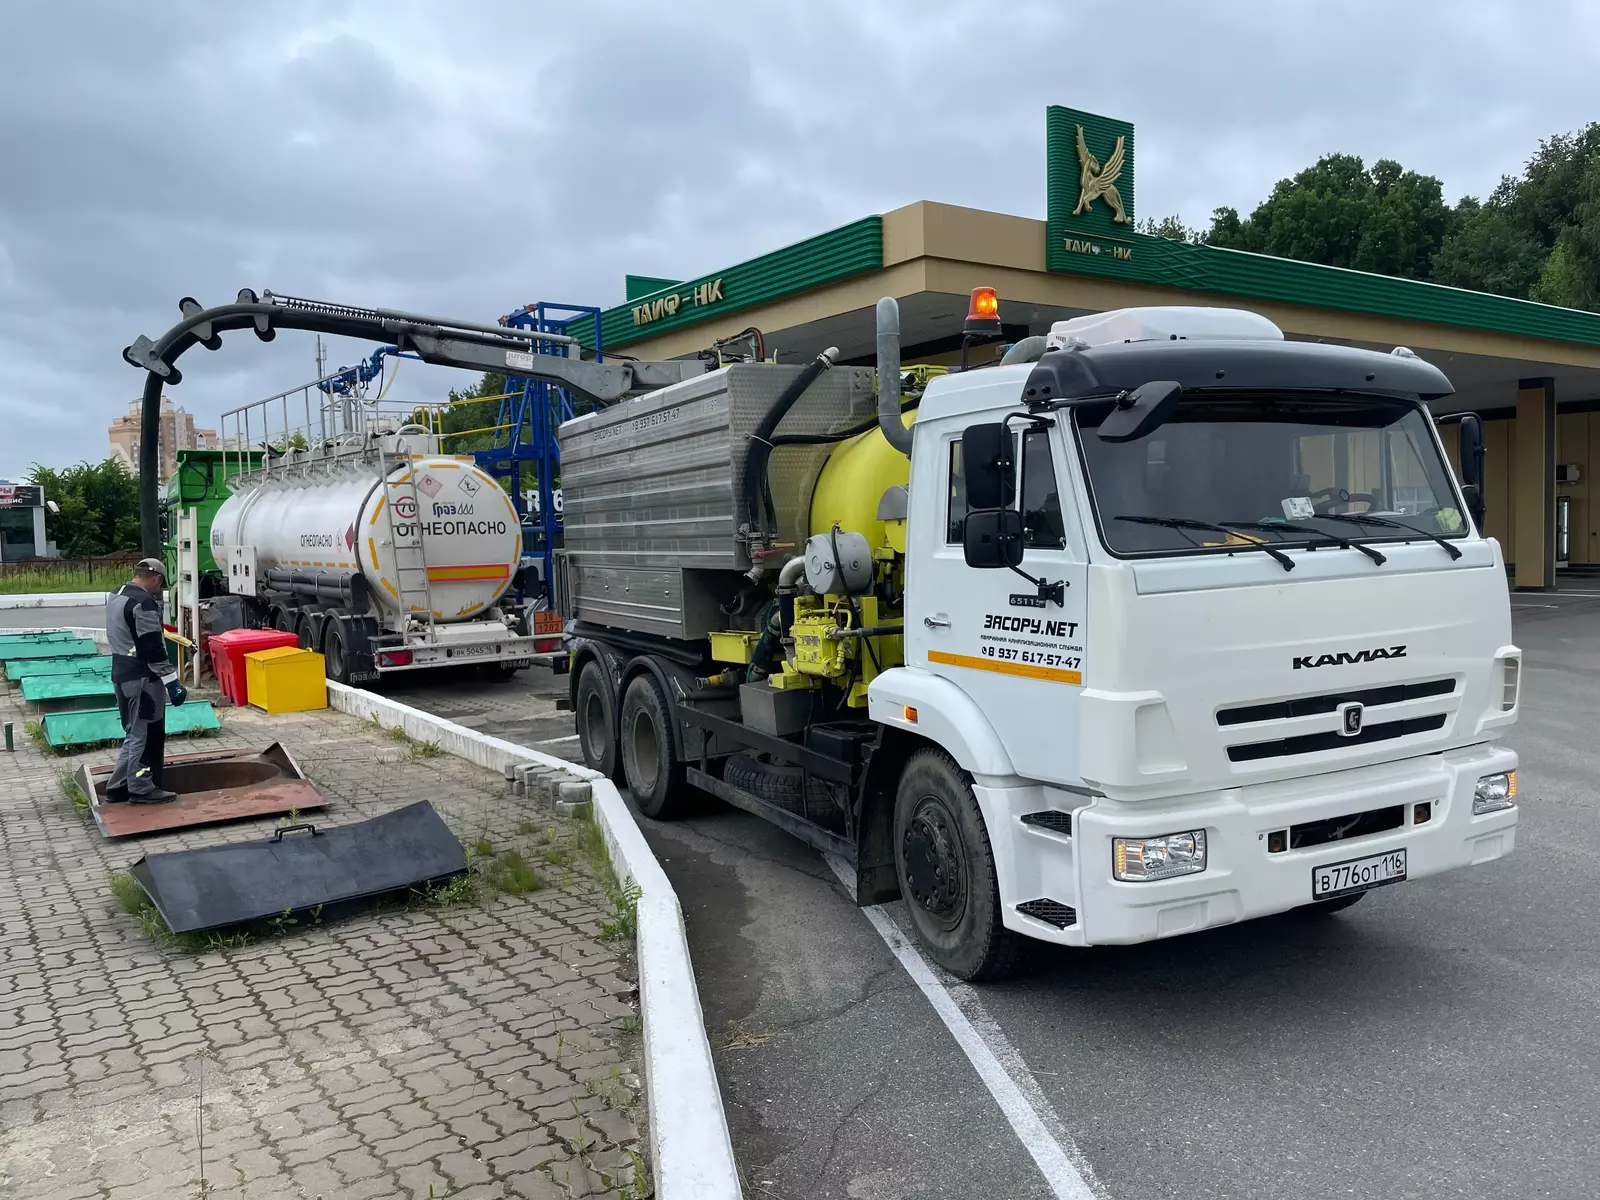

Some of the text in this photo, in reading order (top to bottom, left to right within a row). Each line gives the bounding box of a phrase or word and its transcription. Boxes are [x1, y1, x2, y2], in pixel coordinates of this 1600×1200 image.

[396, 521, 507, 537] ОГНЕОПАСНО
[300, 534, 333, 547] ОГНЕОПАСНО
[543, 612, 554, 622] 30
[539, 623, 560, 633] 1202
[1059, 644, 1083, 652] СЛУЖБА
[988, 646, 1081, 669] 8 937 617-57-47
[1381, 853, 1402, 872] 116
